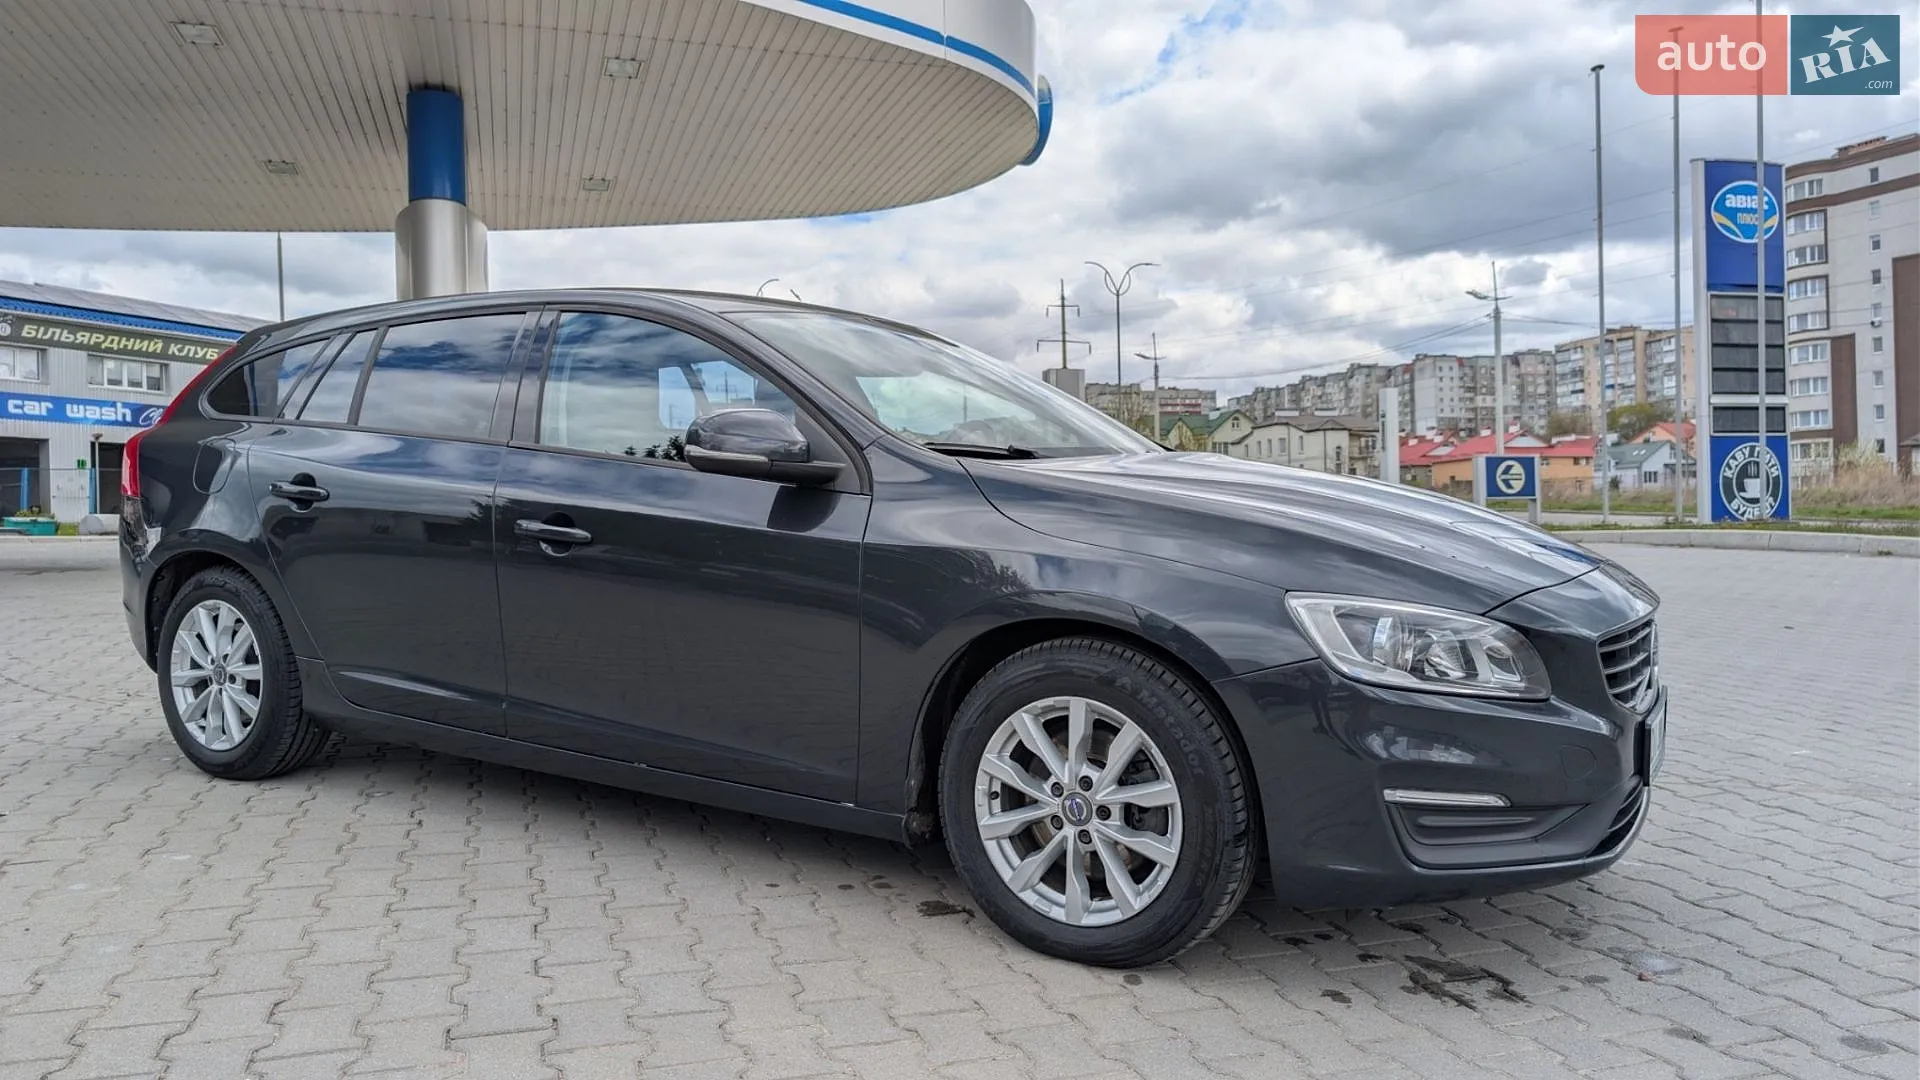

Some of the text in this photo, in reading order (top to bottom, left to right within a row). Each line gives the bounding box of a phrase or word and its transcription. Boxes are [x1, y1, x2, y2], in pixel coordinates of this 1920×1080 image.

[21, 324, 220, 360] БІЛЬЯРДНИЙ КЛУБ
[7, 399, 132, 422] car wash
[1723, 446, 1750, 478] КАВУ
